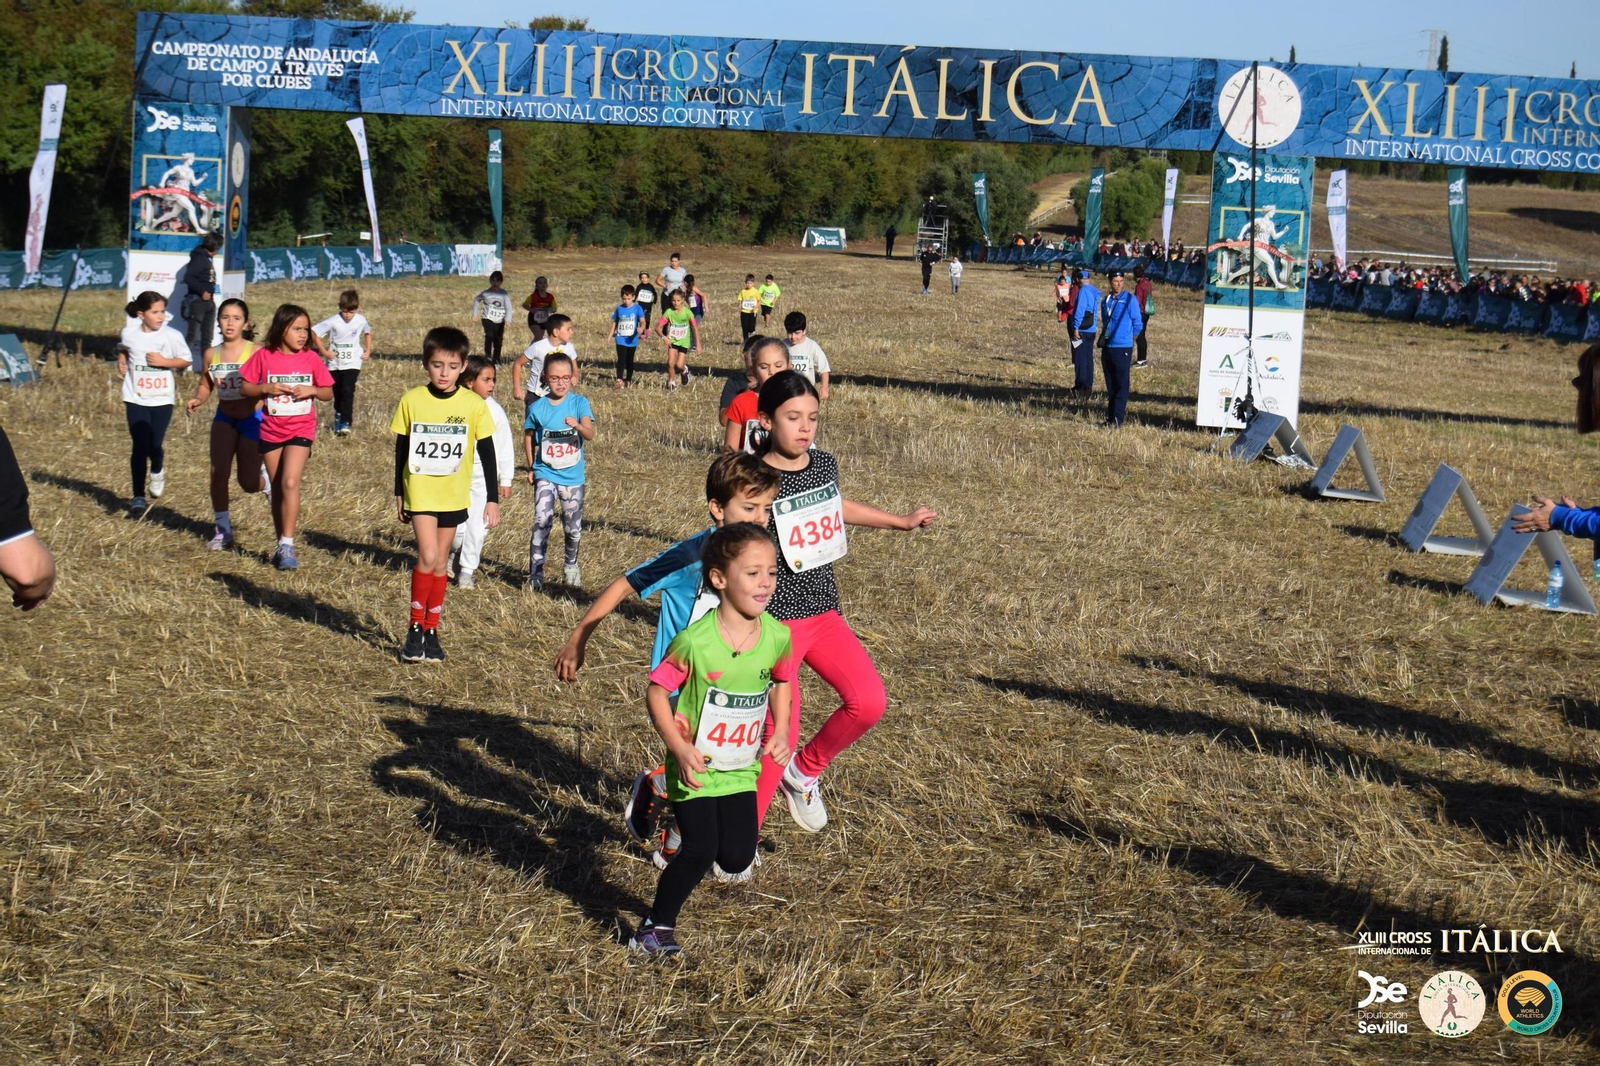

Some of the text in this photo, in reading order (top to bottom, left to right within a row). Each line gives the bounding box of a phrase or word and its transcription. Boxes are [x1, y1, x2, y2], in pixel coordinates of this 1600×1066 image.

[152, 41, 380, 64] CAMPEONATO DE ANDALUCÍA
[187, 57, 344, 77] DE CAMPO A TRAVÉS
[442, 40, 606, 100] XLIII
[611, 48, 740, 84] CROSS
[222, 72, 312, 90] POR CLUBES
[798, 45, 1116, 128] ITÁLICA
[610, 84, 787, 108] INTERNACIONAL
[440, 98, 754, 128] INTERNATIONAL CROSS COUNTRY
[1349, 79, 1520, 143] XLIII
[182, 122, 217, 133] Sevilla
[1345, 139, 1506, 165] INTERNATIONAL
[1510, 148, 1572, 168] CROSS
[1264, 173, 1300, 185] Sevilla
[137, 377, 169, 390] 4501
[415, 441, 463, 460] 4294
[788, 510, 842, 549] 4384
